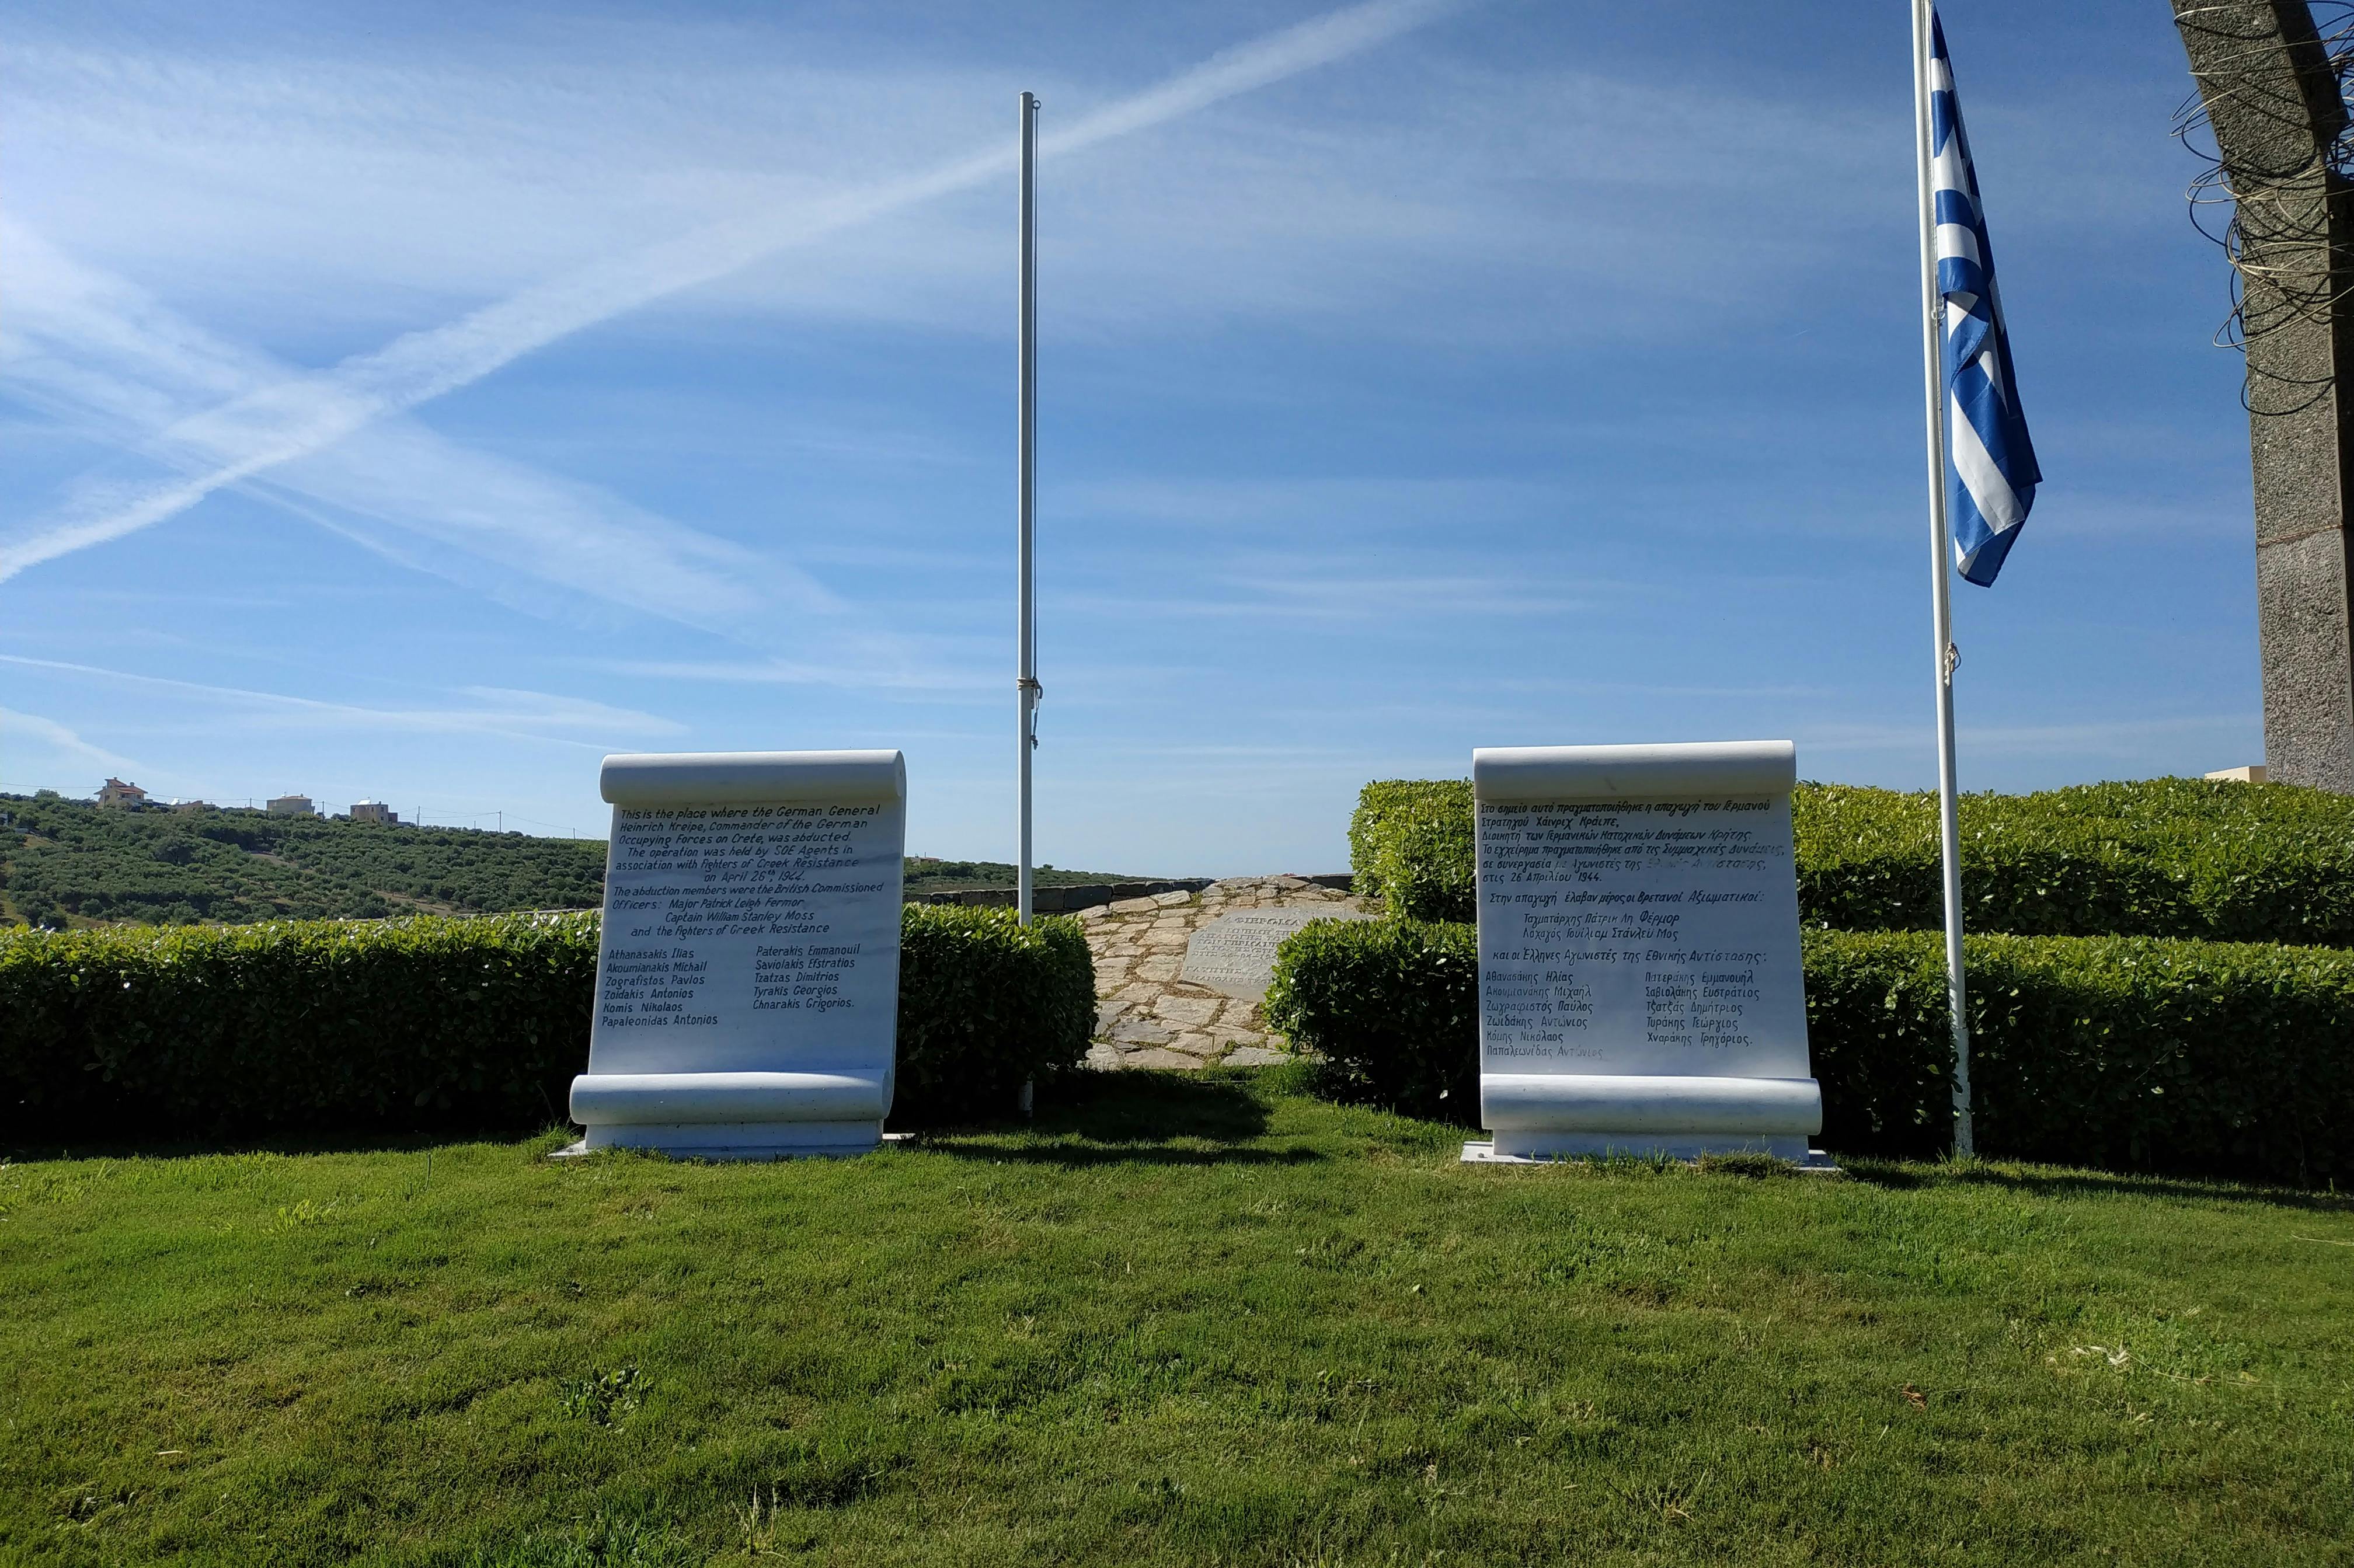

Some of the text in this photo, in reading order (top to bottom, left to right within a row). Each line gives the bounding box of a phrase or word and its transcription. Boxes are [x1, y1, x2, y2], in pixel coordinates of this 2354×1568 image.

[621, 804, 880, 821] This is the place where the German General
[1481, 803, 1495, 814] Στο
[1530, 802, 1554, 813] αυτό
[1645, 803, 1652, 814] η
[1653, 799, 1701, 817] απαγωγή
[1703, 803, 1722, 811] του
[1722, 799, 1770, 813] Γερμανού
[619, 818, 868, 833] Heinrich Kreipe, Commander of the German
[1481, 816, 1530, 831] Στρατηγού
[618, 832, 791, 849] Occupying Forces on Crete, was
[1526, 832, 1544, 841] των
[1546, 829, 1599, 843] Γερμανικών
[1655, 828, 1707, 842] Δυνάμεων
[628, 845, 853, 859] The operation was held by SOE Agents in
[1482, 844, 1492, 855] Το
[1494, 844, 1539, 859] εγχείρημα
[1624, 842, 1643, 855] από
[1646, 845, 1661, 856] τις
[1662, 842, 1727, 857] Συμμαχικές
[615, 860, 673, 870] association
[677, 859, 698, 869] with
[741, 858, 754, 869] of
[793, 857, 859, 868] Resistance
[1482, 860, 1494, 869] σε
[1497, 860, 1552, 873] συνεργασία
[1624, 860, 1642, 872] της
[704, 874, 716, 883] on
[721, 871, 749, 883] April
[778, 870, 805, 881] 1944.
[1482, 871, 1602, 885] στις 26 Απριλίου 1944.
[614, 886, 631, 897] The
[632, 885, 680, 897] abduction
[681, 884, 727, 895] members
[757, 884, 775, 894] the
[774, 883, 809, 894] British
[811, 881, 885, 893] Commissioned
[612, 897, 805, 912] Officers: Major Patrick Leigh Fermor
[1489, 893, 1512, 906] Στην
[1514, 890, 1558, 908] απαγωγή
[1564, 890, 1599, 905] έλαβαν
[1636, 891, 1684, 905] Βρετανοί
[665, 910, 814, 925] Captain William Stanley Moss
[1524, 910, 1680, 929] Ταγματάρχης Πάτρικ Λη Φέρμορ
[630, 926, 652, 937] and
[656, 925, 673, 936] the
[716, 924, 729, 935] of
[768, 922, 830, 934] Resistance
[1656, 928, 1679, 942] Μος
[608, 947, 694, 960] Athanasakis Ilias
[755, 943, 861, 957] Paterakis Emmanouil
[1492, 952, 1509, 960] και
[1512, 952, 1520, 960] οι
[1523, 946, 1561, 963] Έλληνες
[1564, 948, 1618, 964] Αγωνιστές
[1622, 952, 1641, 963] της
[1645, 948, 1687, 964] Εθνικής
[605, 960, 708, 973] Akoumianakis Michail
[755, 957, 855, 970] Saviolakis Efstratios
[605, 974, 705, 990] Zografistos Pavlos
[755, 971, 840, 983] Tzatzas Dimitrios
[1485, 970, 1574, 985] Αθανασάκης Ηλίας
[1701, 969, 1754, 987] Εμμανουήλ
[604, 987, 694, 1000] Zoidakis Antonios
[754, 984, 838, 999] Tyrakis Georgios
[1554, 984, 1592, 999] Μιχαήλ
[1645, 985, 1760, 1001] Σαβιολάκης Ευστράτιος
[603, 1001, 683, 1013] Komis Nikolaos
[753, 997, 855, 1013] Chnarakis Grigorios.
[1486, 999, 1593, 1016] Ζωγραφιστός Παύλος
[1646, 999, 1743, 1016] Τζατζάς Δημήτριος
[601, 1013, 718, 1029] Papaleonidas Antonios
[1541, 1015, 1588, 1030] Αντώνιος
[1646, 1016, 1739, 1033] Τυράκης Γεώργιος
[1486, 1029, 1563, 1044] Κόμης Νικόλαος
[1646, 1031, 1693, 1047] Χναράκης
[1486, 1044, 1553, 1059] Παπαλεωνίδας
